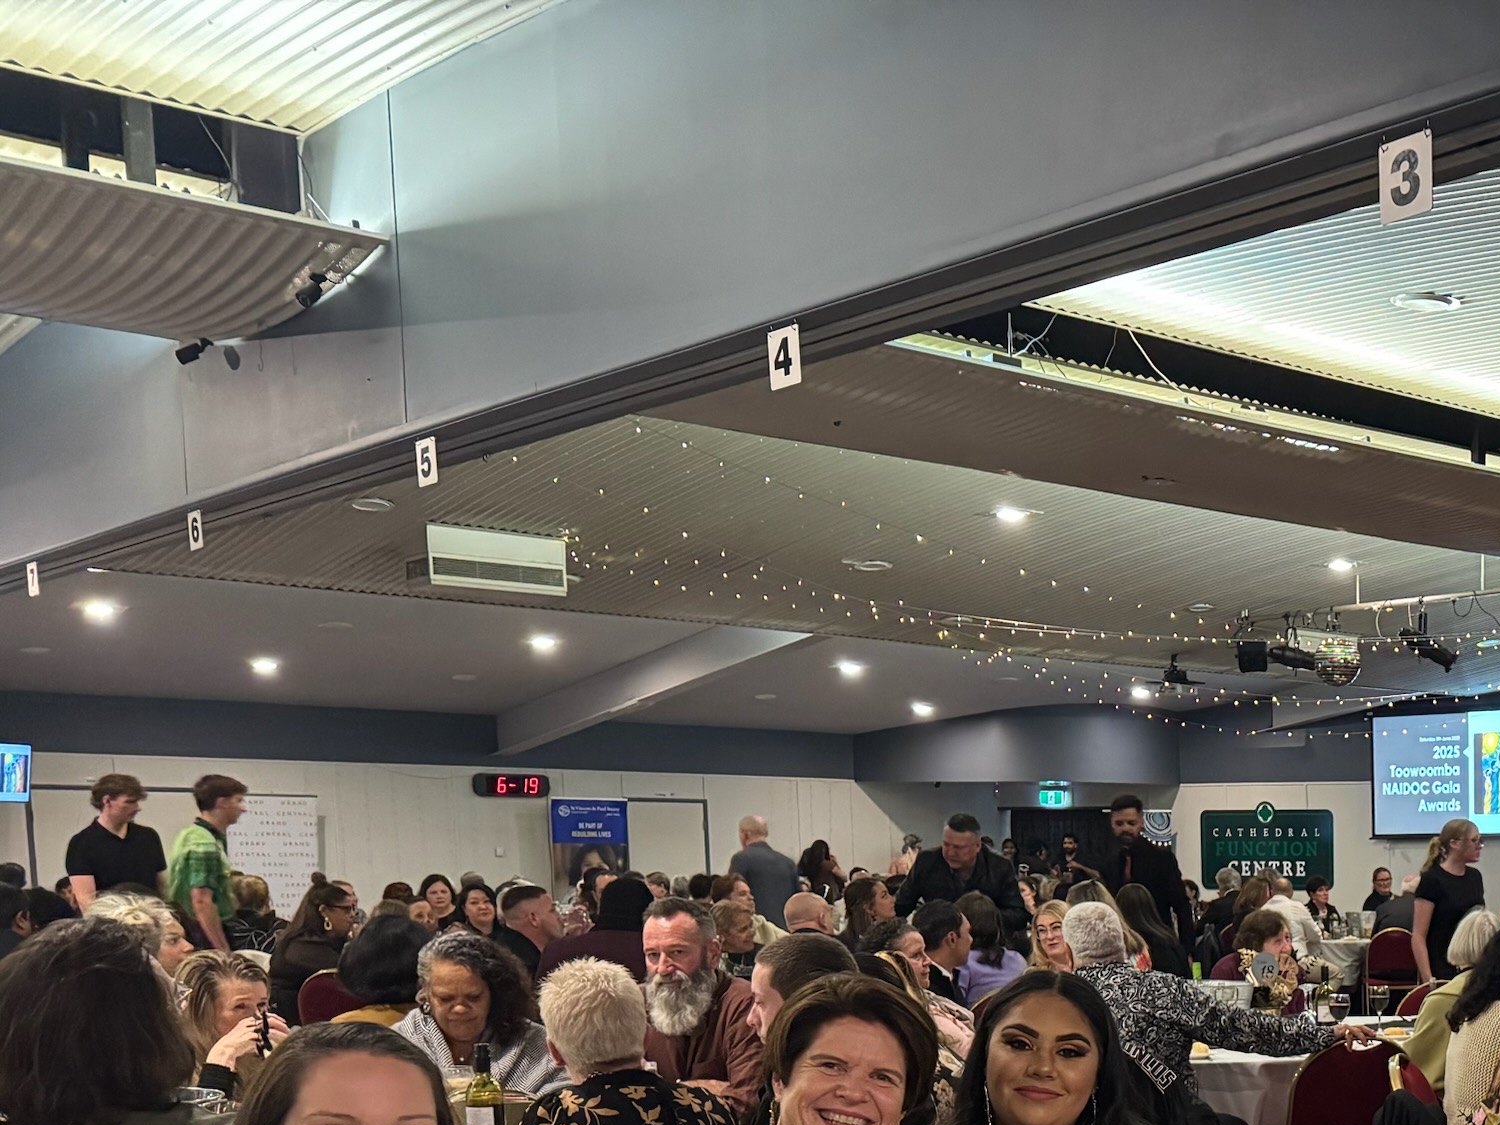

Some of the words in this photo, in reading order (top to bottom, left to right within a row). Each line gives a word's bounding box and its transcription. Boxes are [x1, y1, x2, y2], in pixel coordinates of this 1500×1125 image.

[1390, 147, 1421, 207] 3
[774, 335, 793, 377] 4
[420, 446, 432, 479] 5
[191, 517, 200, 542] 6
[28, 569, 36, 588] 7
[1432, 745, 1461, 759] 2025
[1389, 763, 1461, 778] Toowoomba
[1382, 781, 1430, 796] NAIDOC
[1431, 780, 1461, 795] Gala
[1418, 798, 1461, 812] Awards
[1212, 827, 1321, 838] CATHEDRAL
[1215, 841, 1319, 857] FUNCTION
